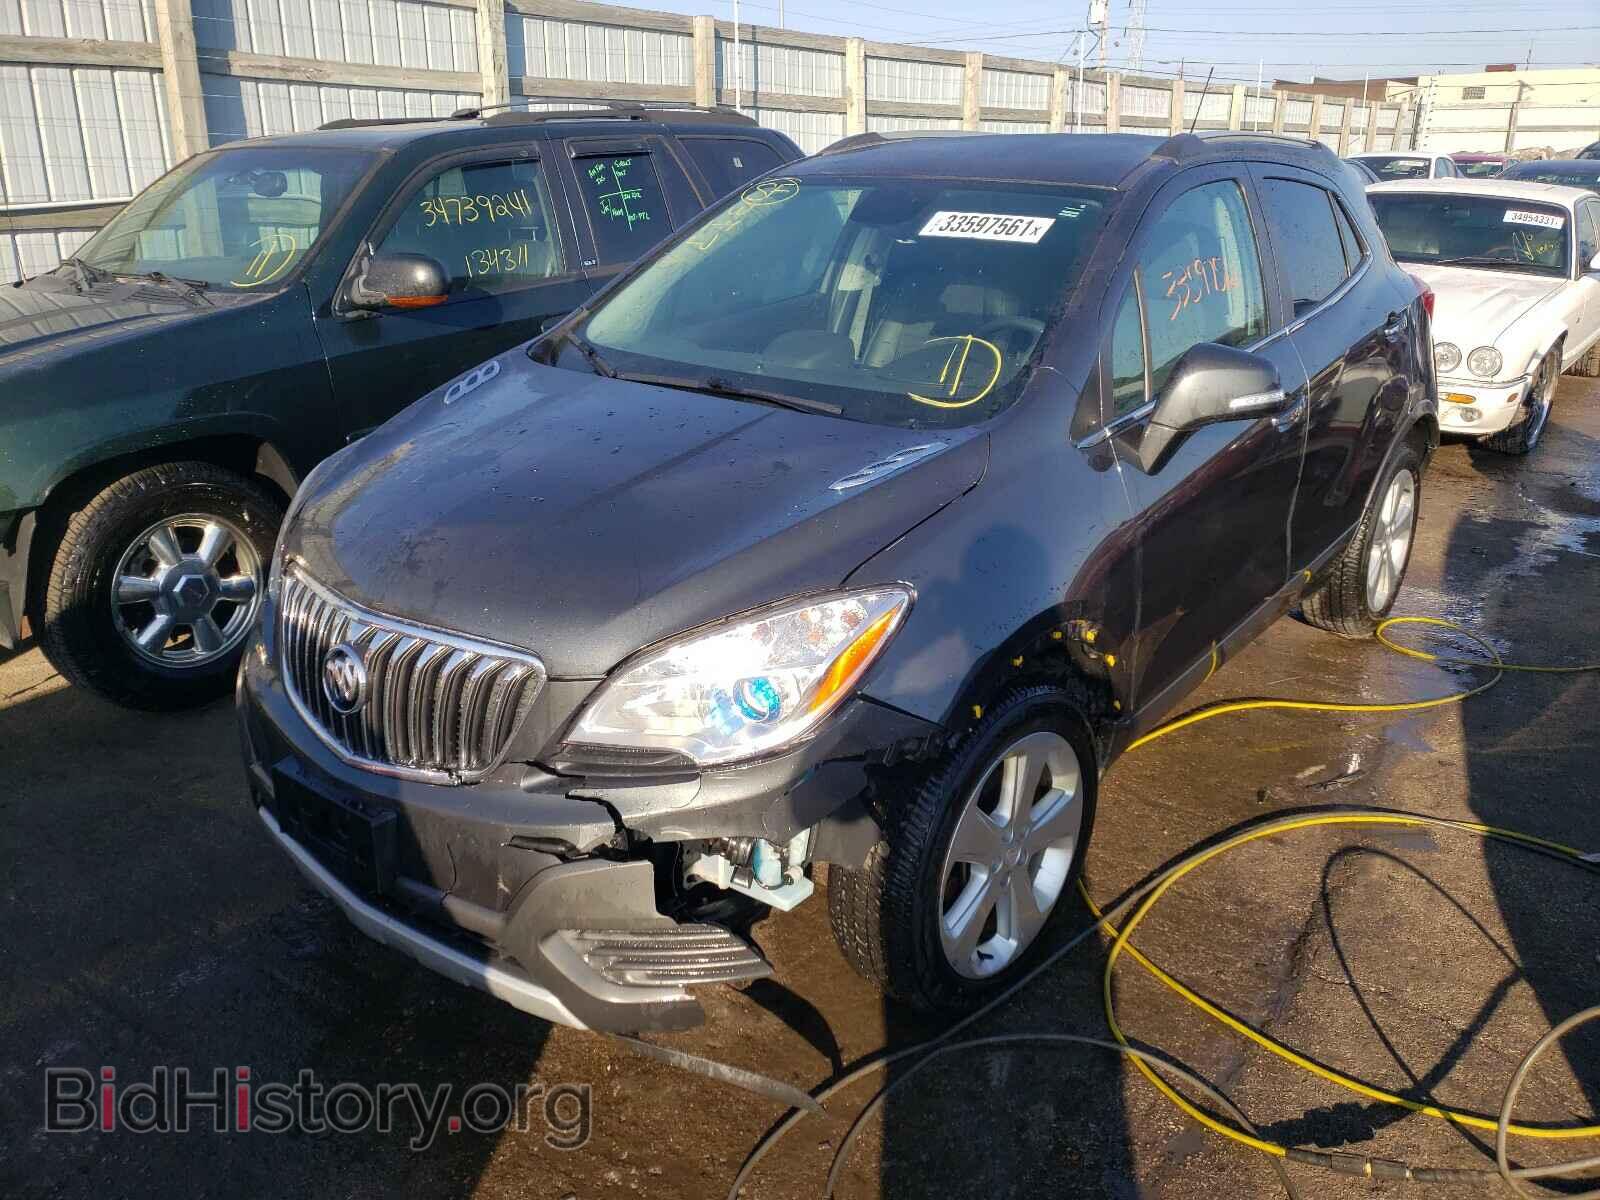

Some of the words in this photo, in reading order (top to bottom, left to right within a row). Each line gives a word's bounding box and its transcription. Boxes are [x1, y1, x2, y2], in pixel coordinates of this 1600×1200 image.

[420, 188, 533, 227] 34739241
[939, 214, 1034, 237] 33597561
[464, 244, 529, 278] 134311
